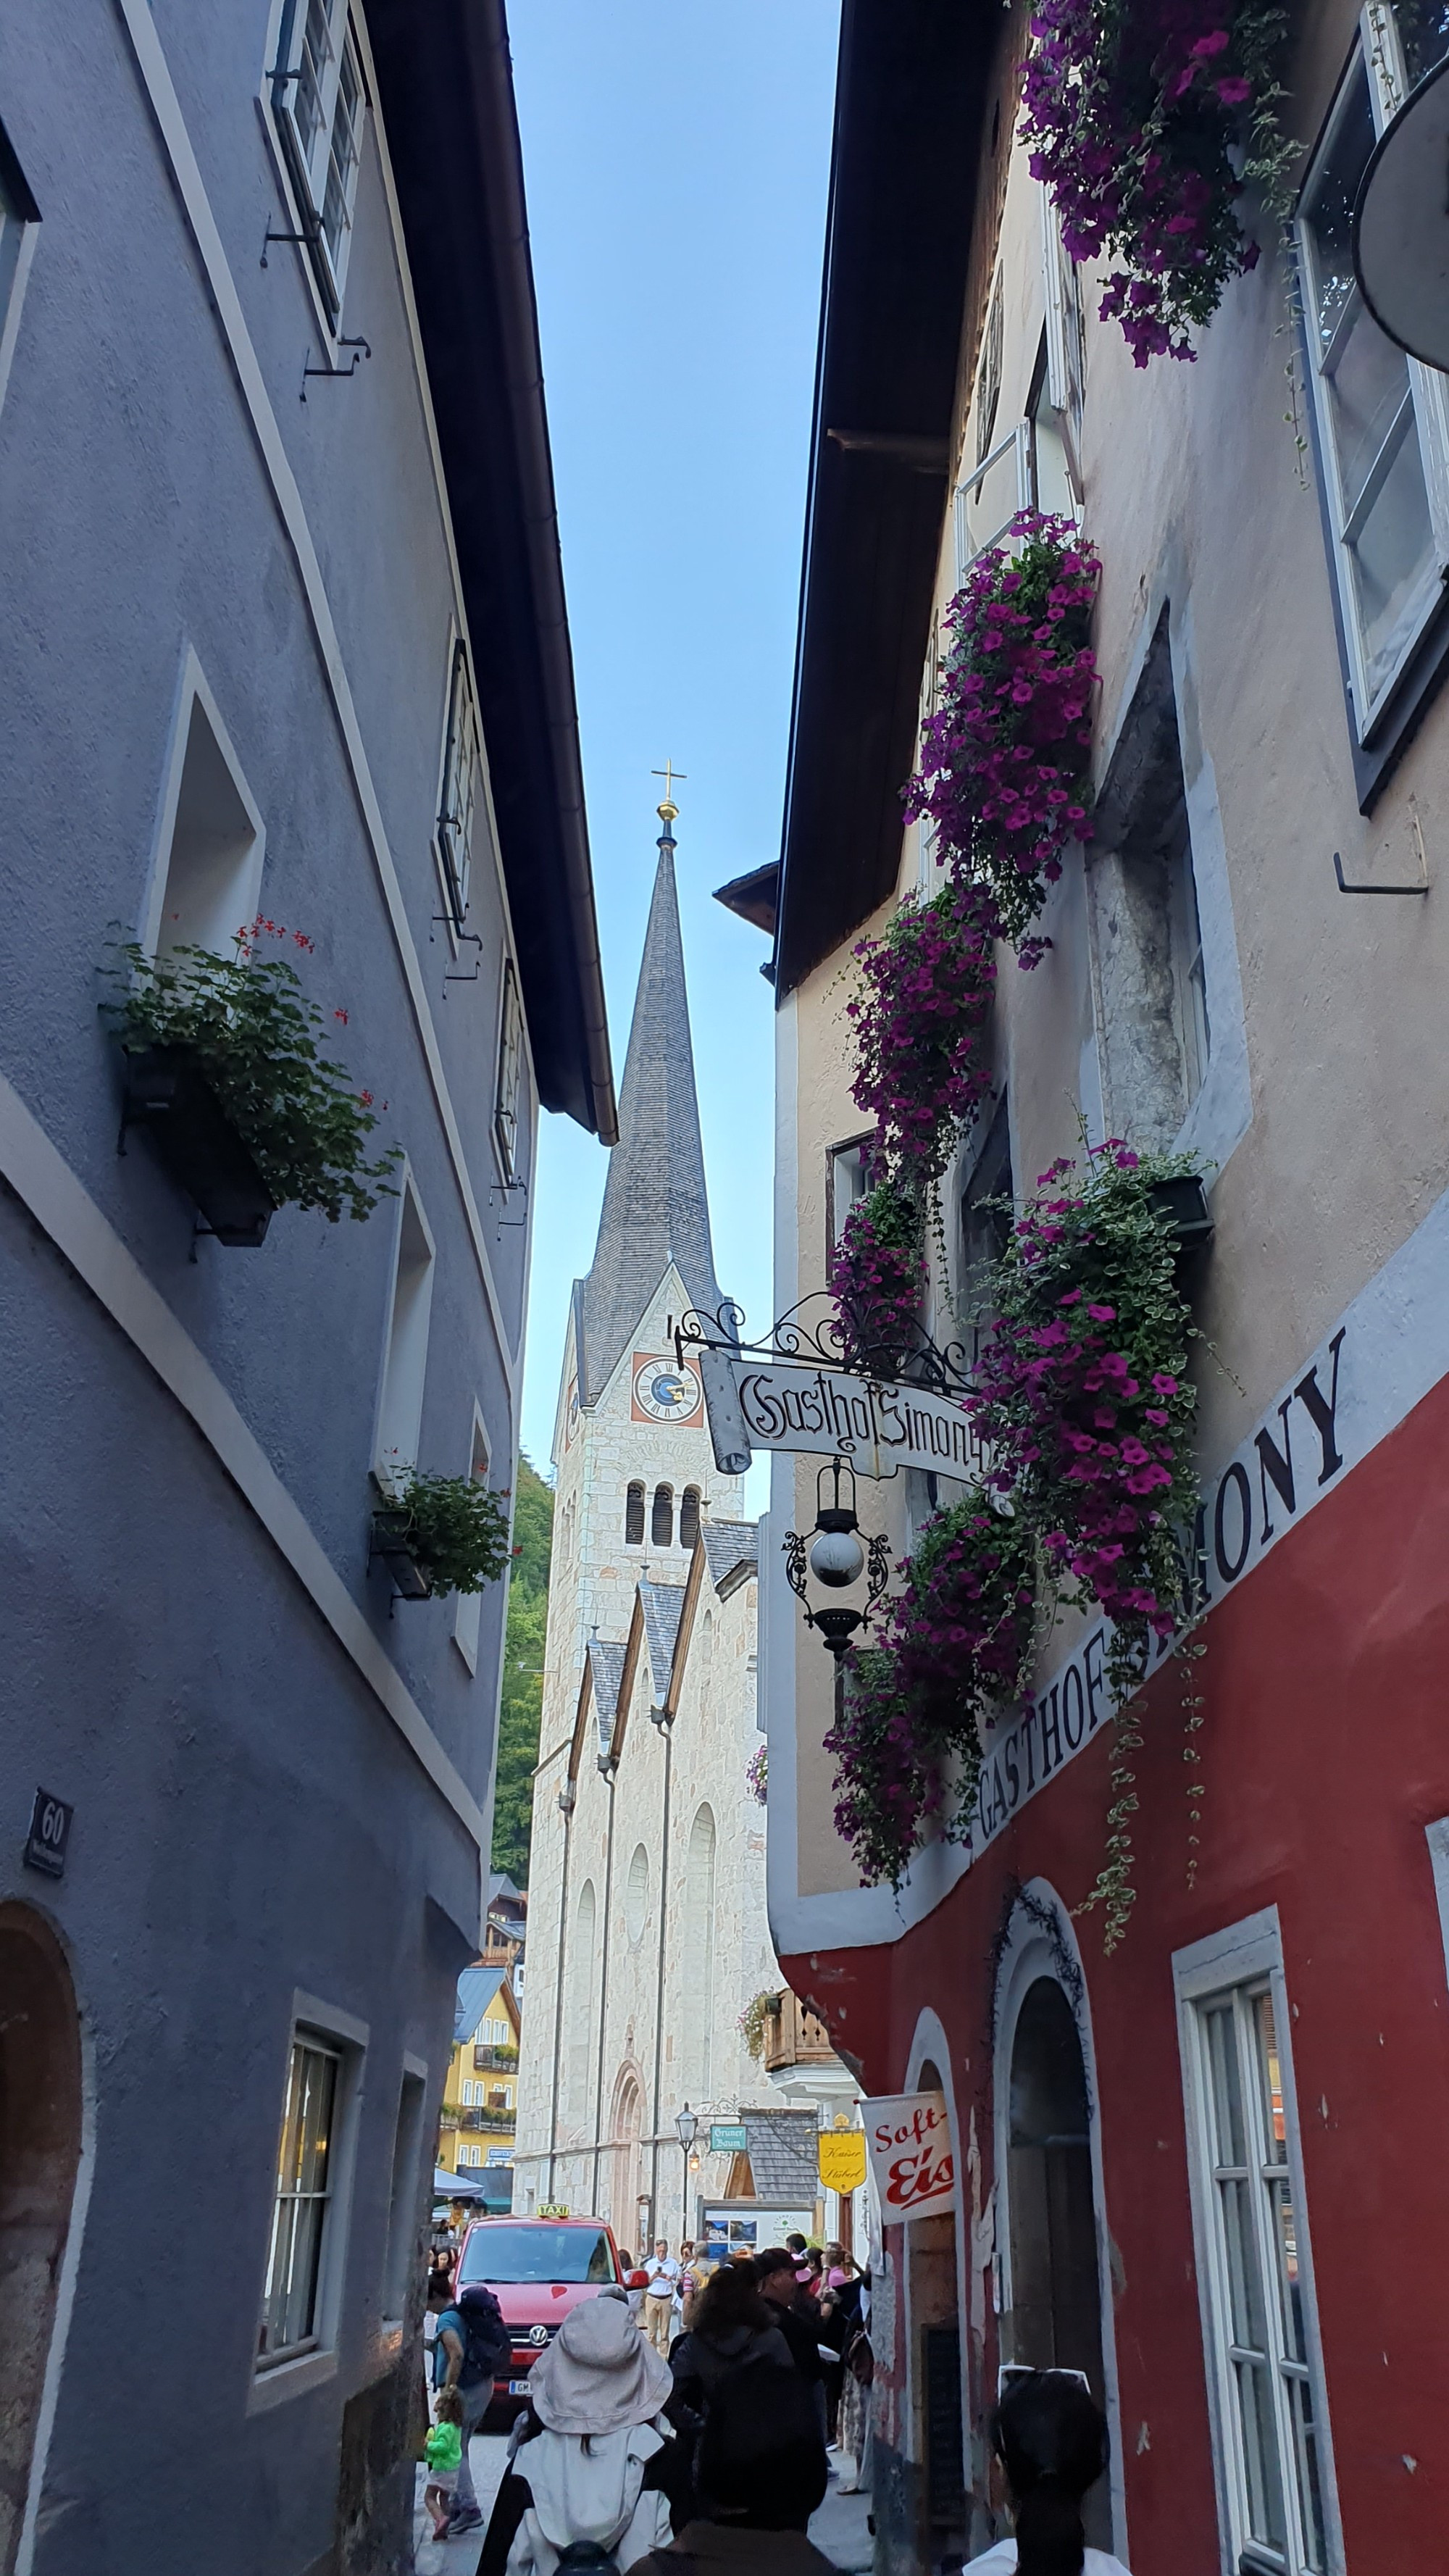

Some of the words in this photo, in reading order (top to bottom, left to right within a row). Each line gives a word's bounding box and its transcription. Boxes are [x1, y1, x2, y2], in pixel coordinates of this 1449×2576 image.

[739, 1371, 880, 1452] Gasthof
[980, 1627, 1106, 1841] GASTHOF
[42, 1801, 64, 1845] 60
[716, 2138, 741, 2148] Baum
[823, 2146, 861, 2158] Kaiser
[875, 2107, 948, 2153] Soft-
[886, 2146, 954, 2205] Eis
